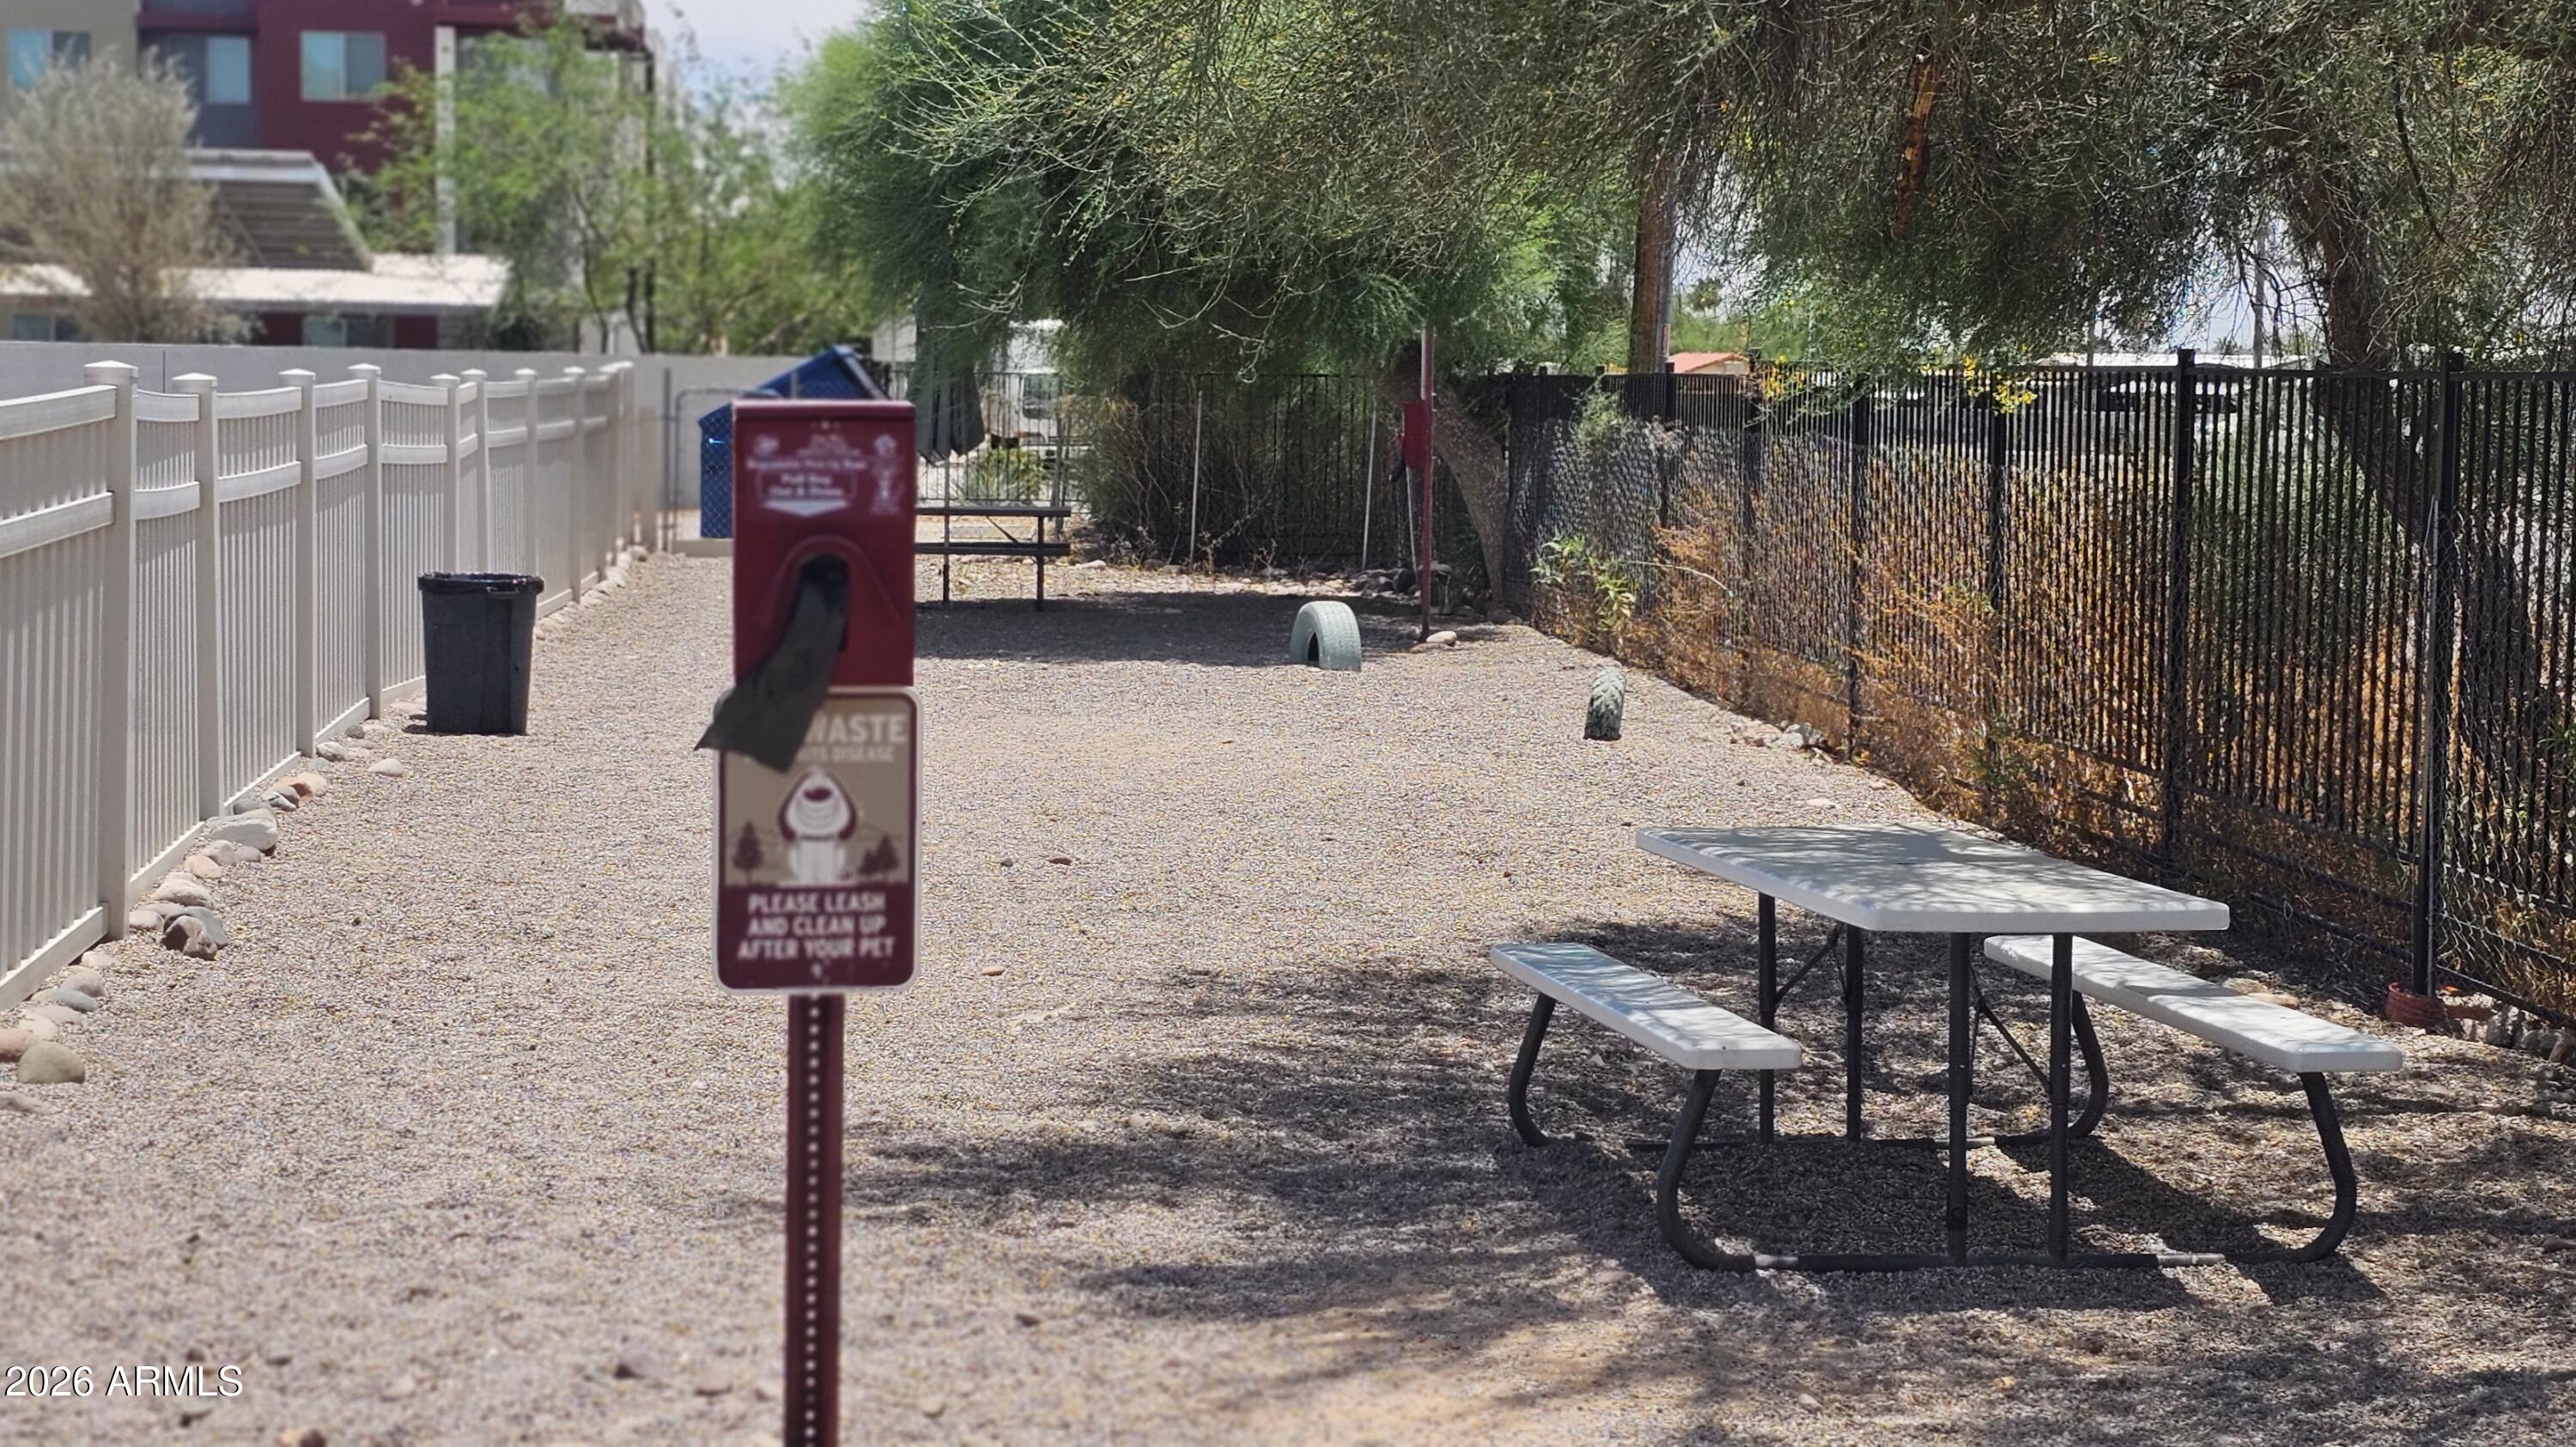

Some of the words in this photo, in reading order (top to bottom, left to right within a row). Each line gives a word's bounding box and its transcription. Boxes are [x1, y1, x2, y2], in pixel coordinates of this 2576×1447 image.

[748, 892, 818, 915] PLEASE
[824, 891, 886, 912] LEASH
[747, 916, 788, 937] AND
[793, 915, 854, 936] CLEAN
[860, 914, 886, 933] UP
[737, 939, 799, 960] AFTER
[803, 937, 854, 958] YOUR
[859, 936, 895, 958] PET
